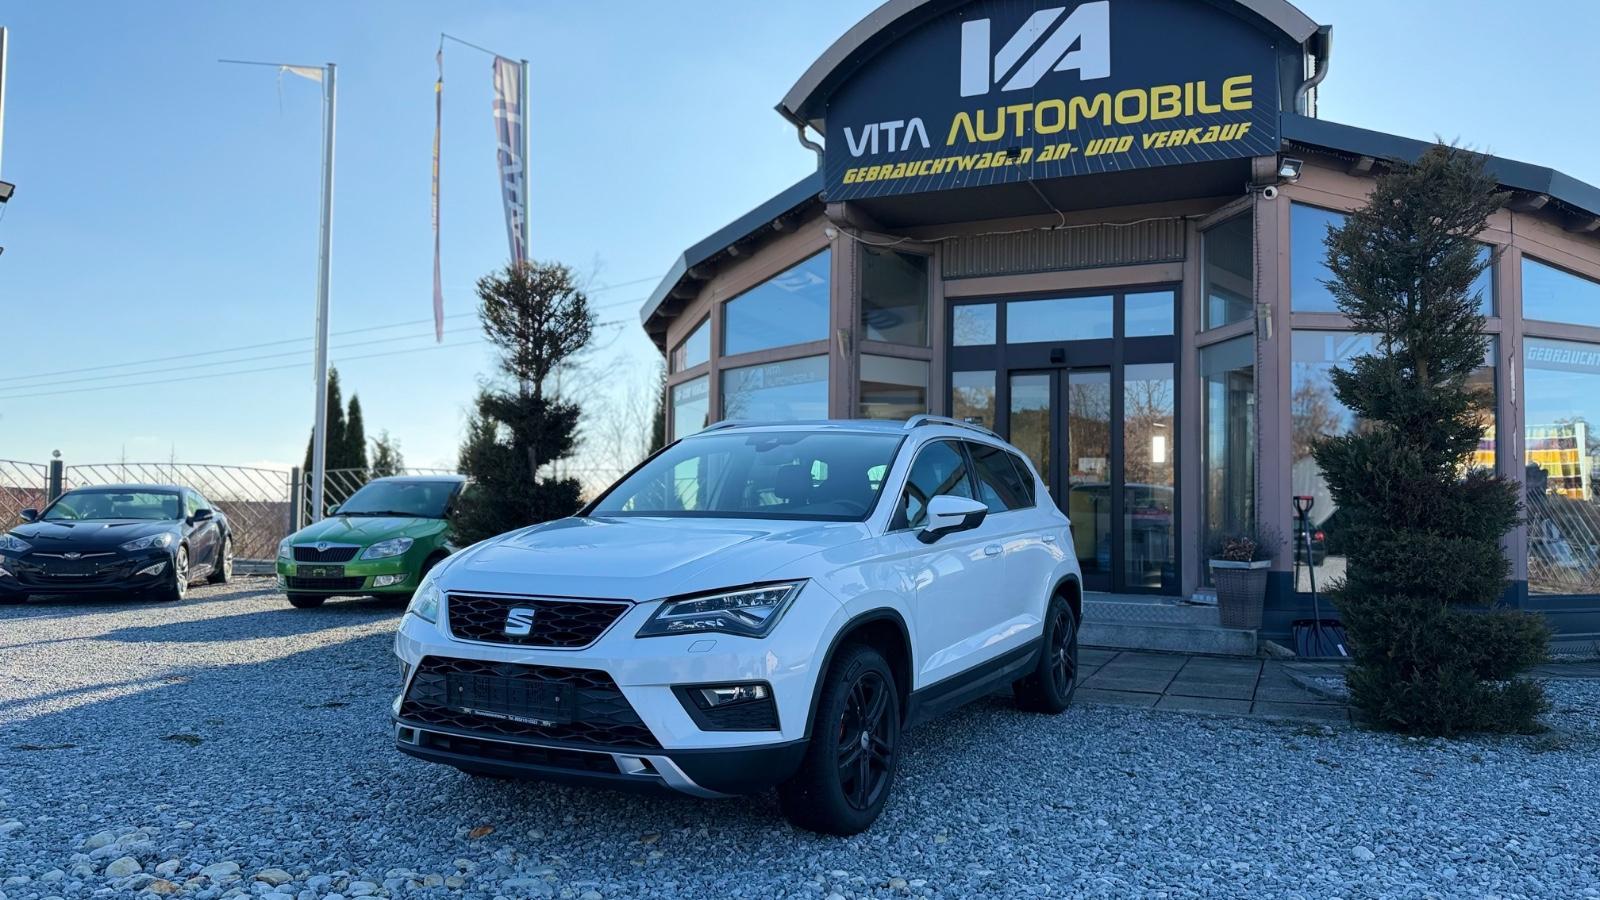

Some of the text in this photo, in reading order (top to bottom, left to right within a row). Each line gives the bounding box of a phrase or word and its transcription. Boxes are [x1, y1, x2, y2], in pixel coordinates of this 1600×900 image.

[843, 75, 1253, 157] VITA AUTOMOBILE
[1084, 136, 1134, 157] UND
[1142, 122, 1252, 150] VERKAUF
